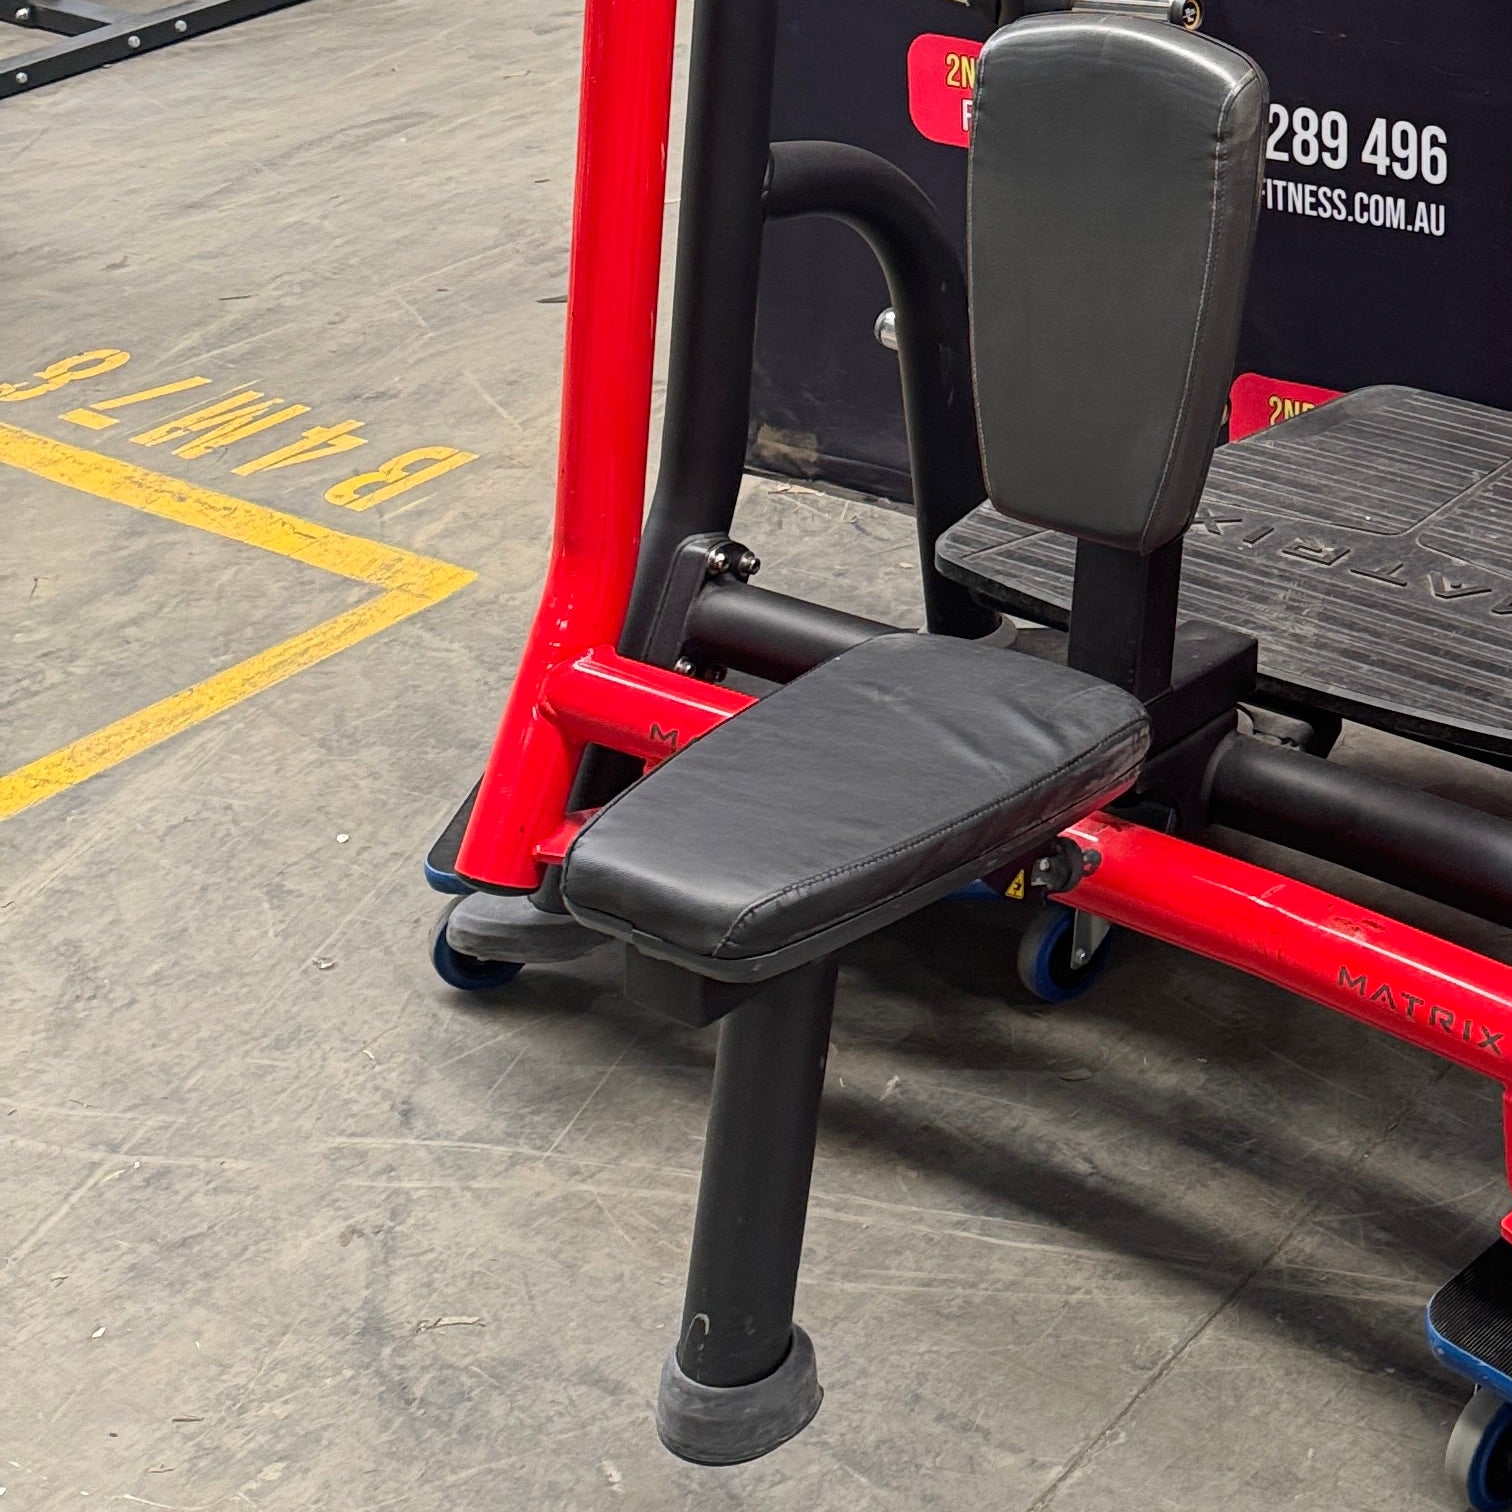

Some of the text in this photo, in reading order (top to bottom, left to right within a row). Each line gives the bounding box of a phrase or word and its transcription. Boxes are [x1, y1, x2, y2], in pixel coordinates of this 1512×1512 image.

[1265, 103, 1448, 185] 289 496
[1262, 178, 1446, 237] ITNESS.COM.AU
[1339, 966, 1504, 1055] MATRIX
